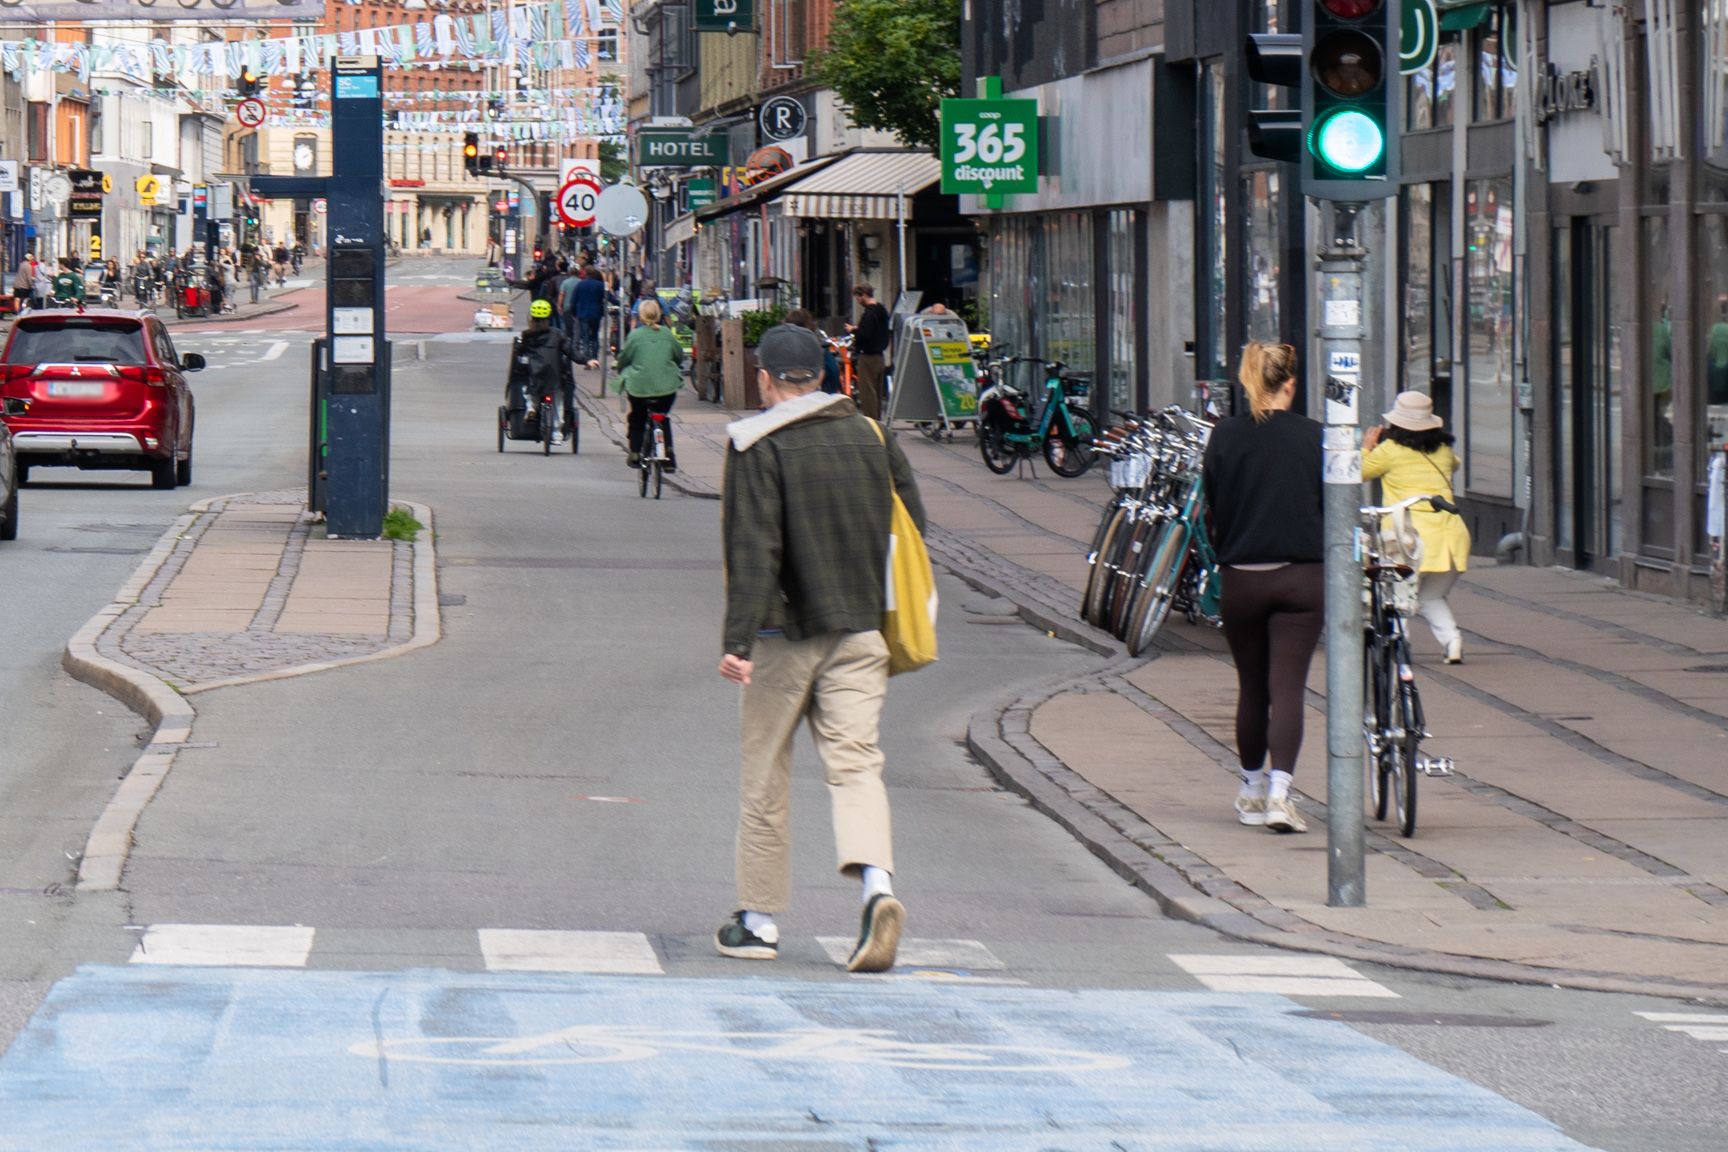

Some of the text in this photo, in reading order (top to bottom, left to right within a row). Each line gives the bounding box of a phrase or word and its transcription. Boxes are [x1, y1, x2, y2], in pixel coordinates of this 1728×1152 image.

[776, 107, 792, 128] R
[649, 141, 714, 156] HOTEL
[953, 122, 1026, 164] 365
[954, 164, 1025, 182] discount
[566, 193, 594, 210] 40
